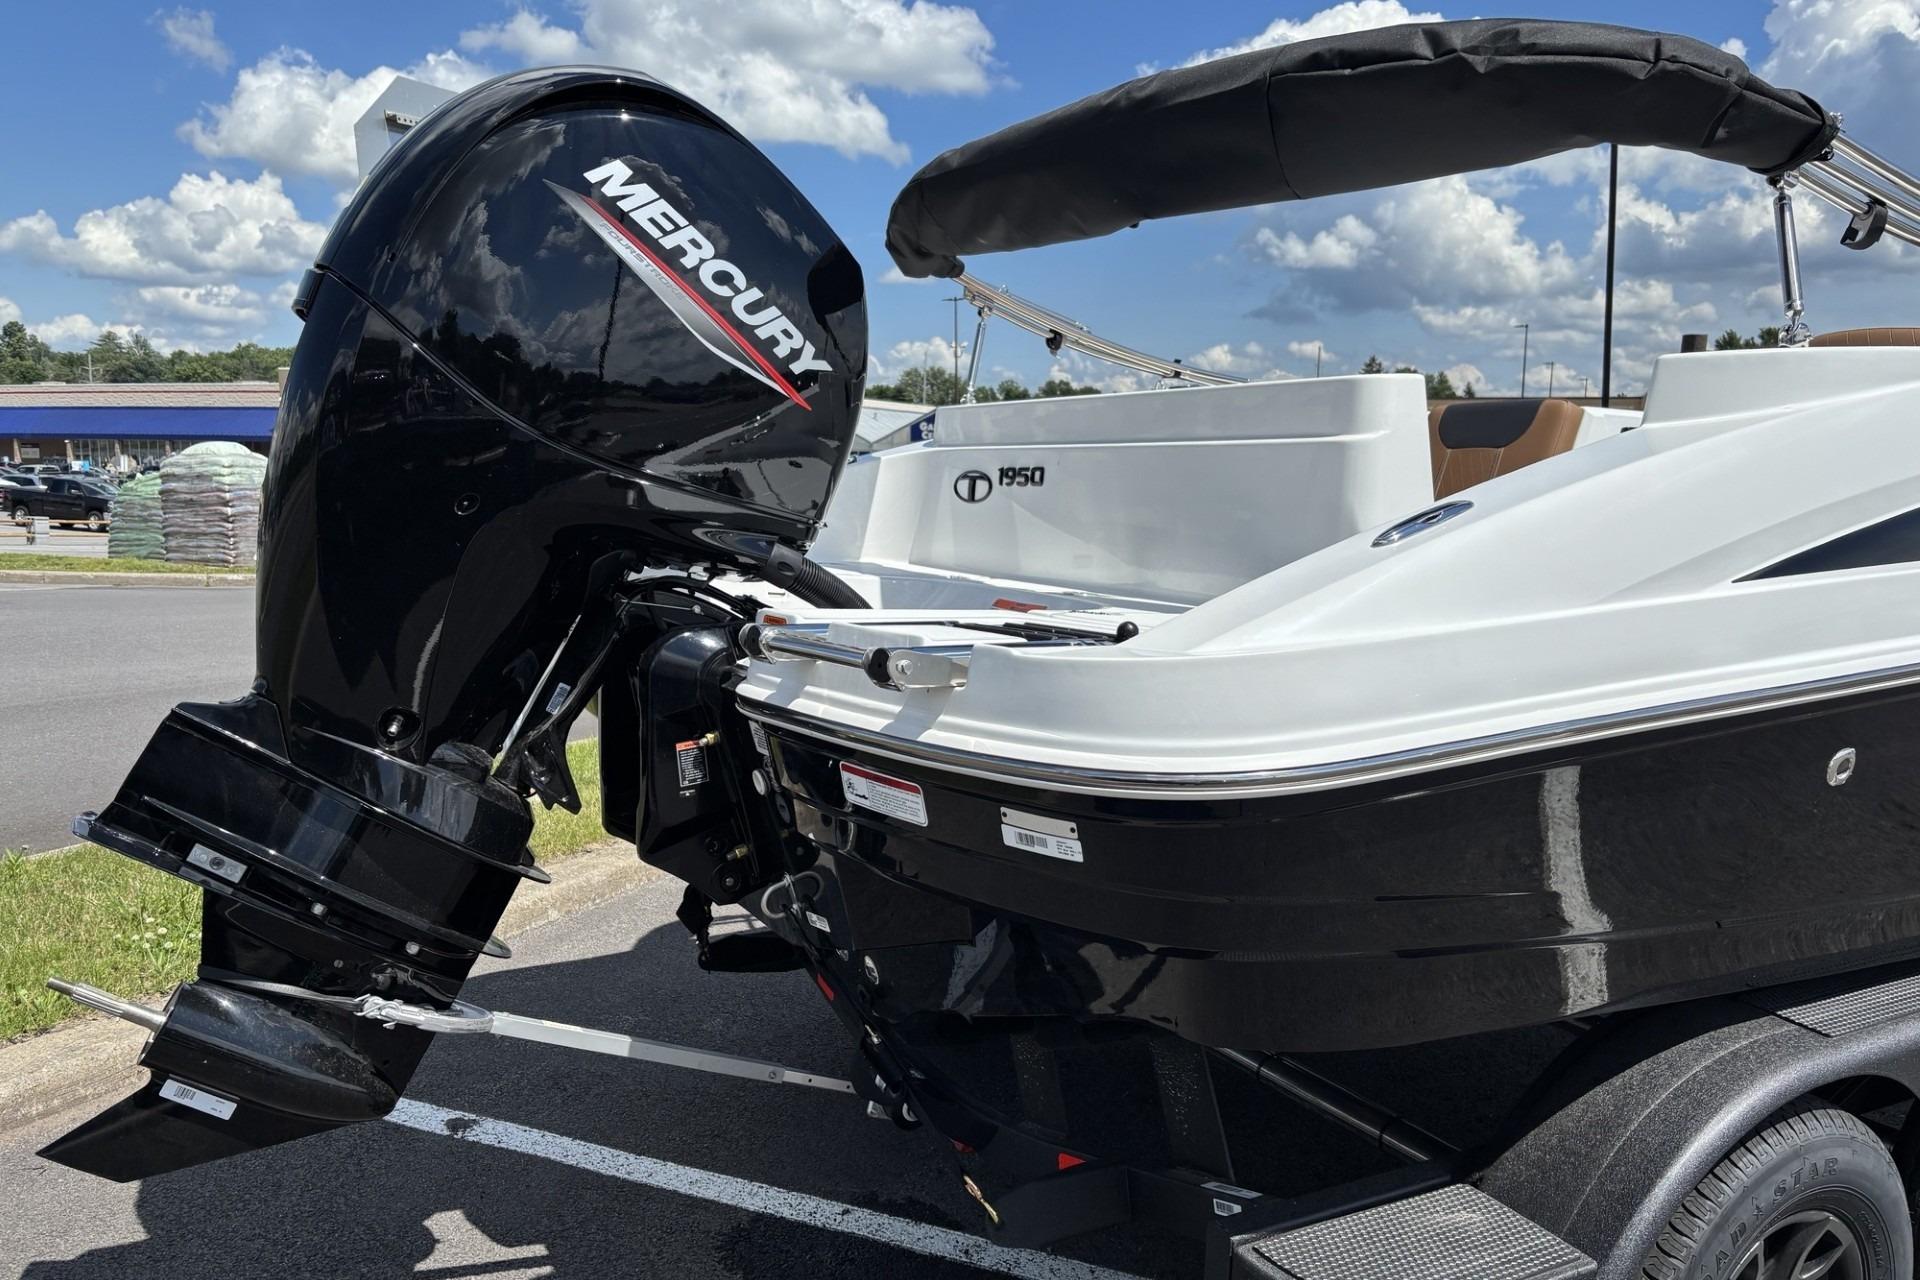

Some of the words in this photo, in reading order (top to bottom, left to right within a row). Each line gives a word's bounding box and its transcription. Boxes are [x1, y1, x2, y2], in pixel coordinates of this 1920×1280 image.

[583, 159, 833, 375] MERCURY
[599, 222, 687, 299] FOURSTROKE
[998, 466, 1045, 487] 1950
[1773, 1156, 1839, 1204] STAR
